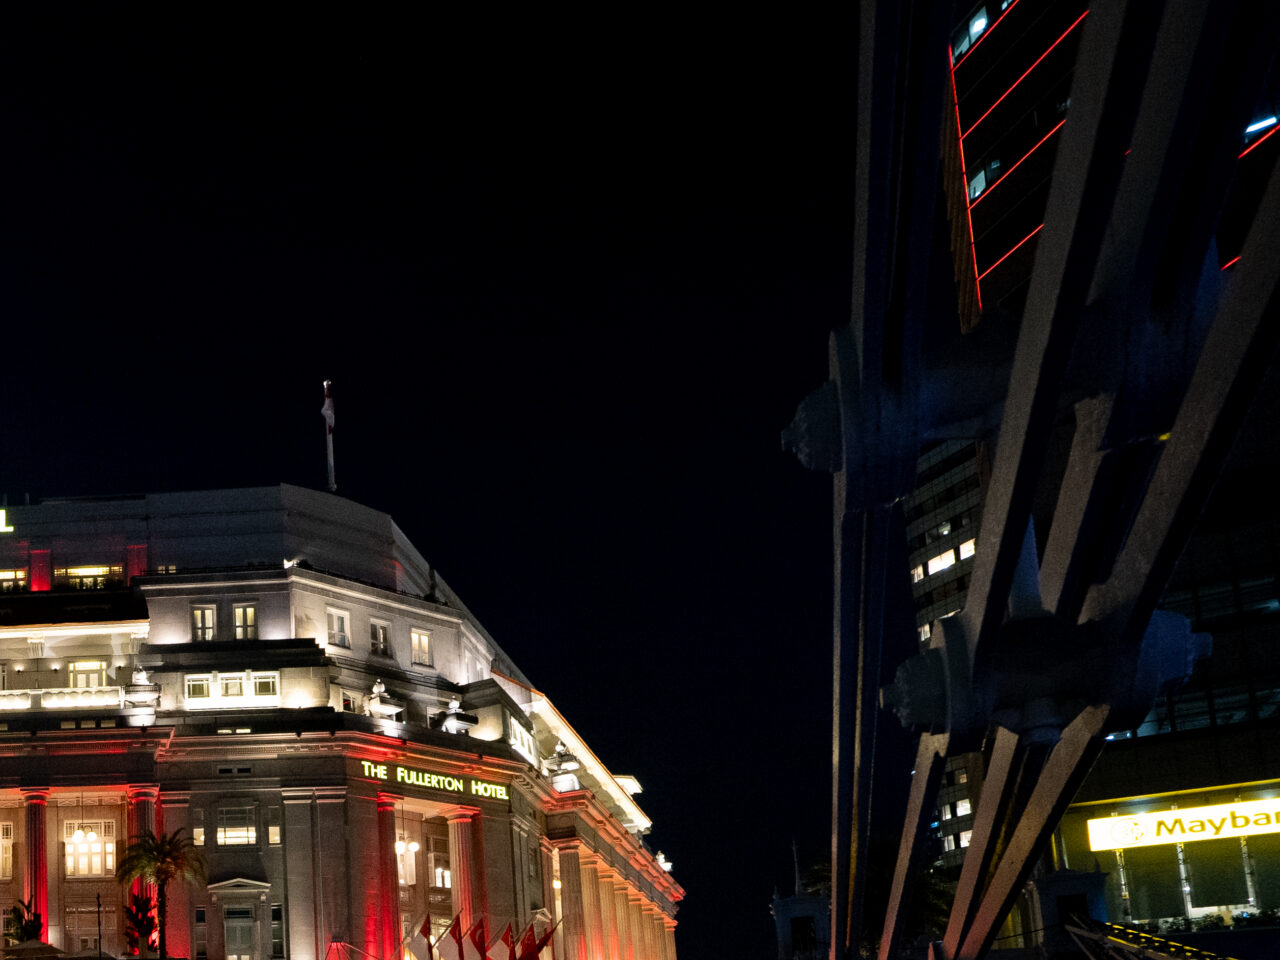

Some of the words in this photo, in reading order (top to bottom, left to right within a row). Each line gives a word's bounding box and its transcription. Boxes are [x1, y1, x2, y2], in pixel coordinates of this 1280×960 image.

[361, 761, 388, 779] THE
[396, 767, 464, 792] FULLERTON
[471, 780, 509, 800] HOTEL
